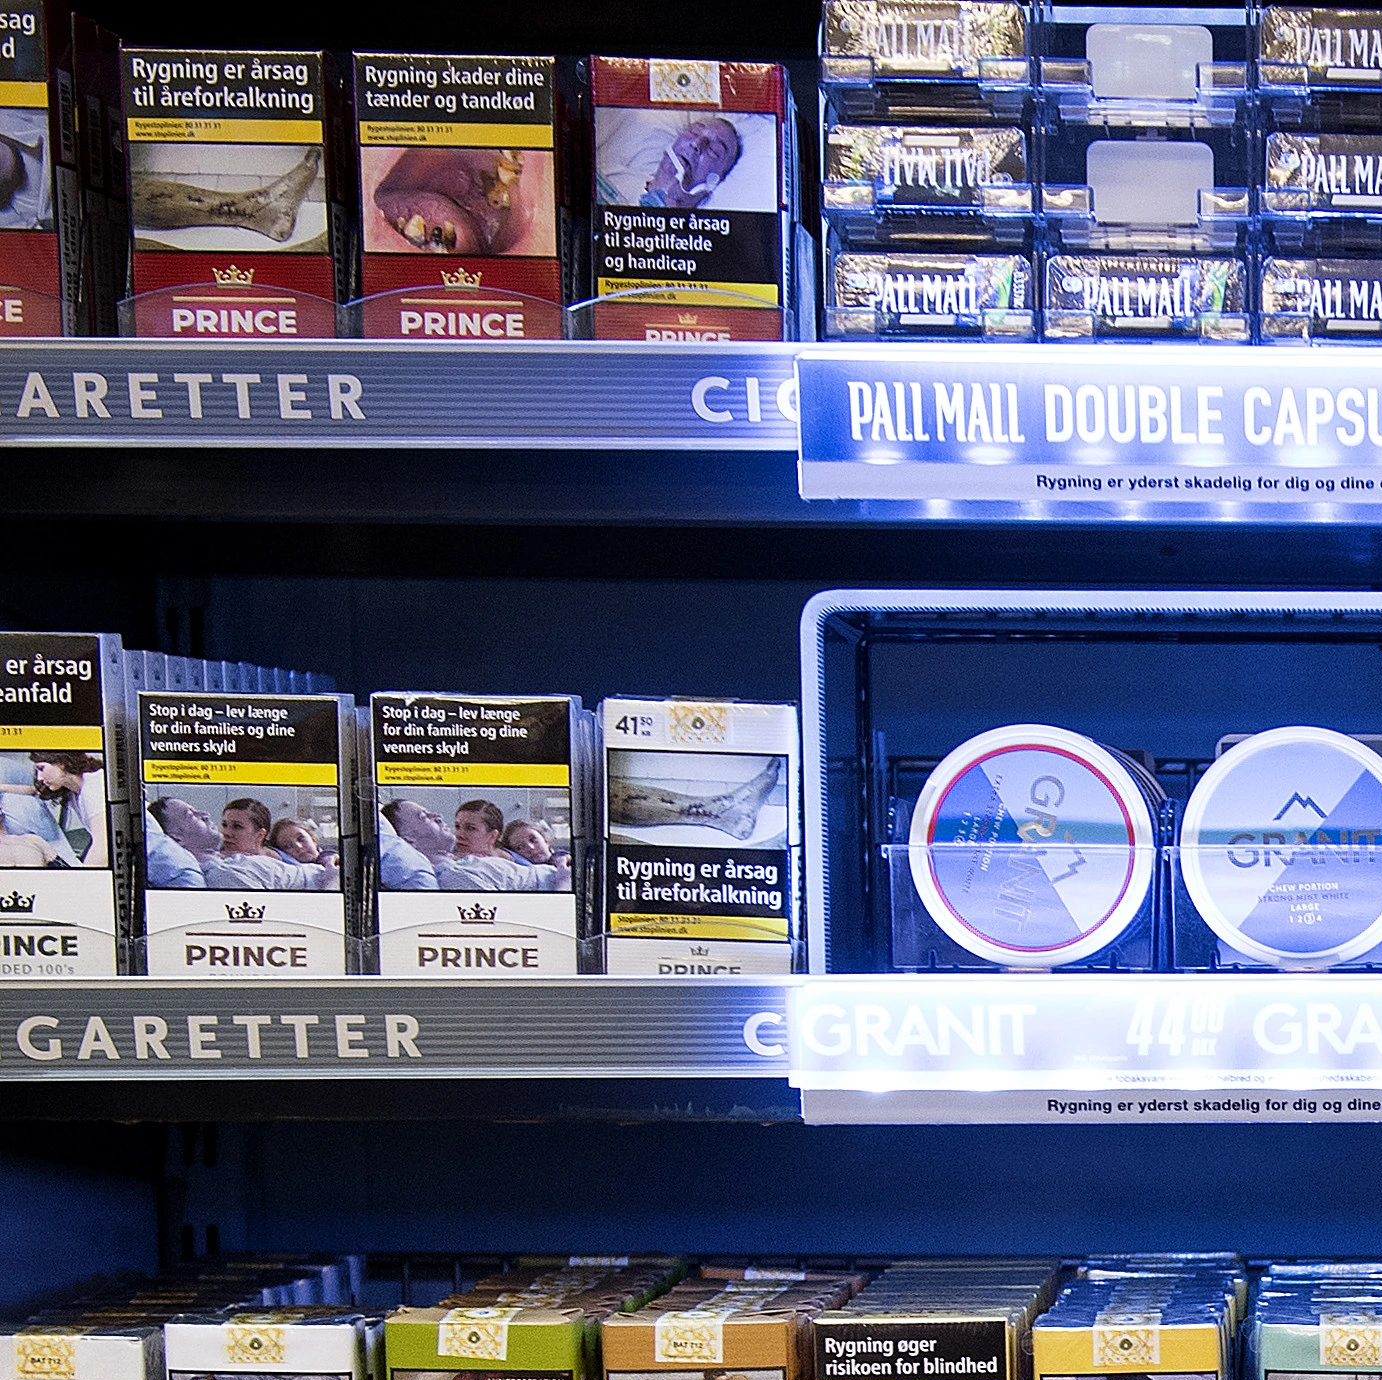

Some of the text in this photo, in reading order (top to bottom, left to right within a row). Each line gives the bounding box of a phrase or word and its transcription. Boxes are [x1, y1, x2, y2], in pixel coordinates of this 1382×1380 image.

[133, 58, 307, 85] Rygning er årsag
[133, 85, 313, 113] til åreforkalkning
[173, 309, 296, 333] PRINCE
[848, 380, 930, 443] PALL
[933, 382, 1024, 443] MALL
[1046, 385, 1223, 445] DOUBLE
[1037, 475, 1101, 490] Rygning
[1108, 479, 1123, 488] er
[1129, 476, 1179, 490] yderst
[1185, 476, 1251, 491] skadelig
[1258, 477, 1279, 489] for
[1285, 477, 1309, 491] dig
[1315, 480, 1335, 492] og
[1341, 477, 1374, 489] dine
[1290, 902, 1320, 913] LARGE
